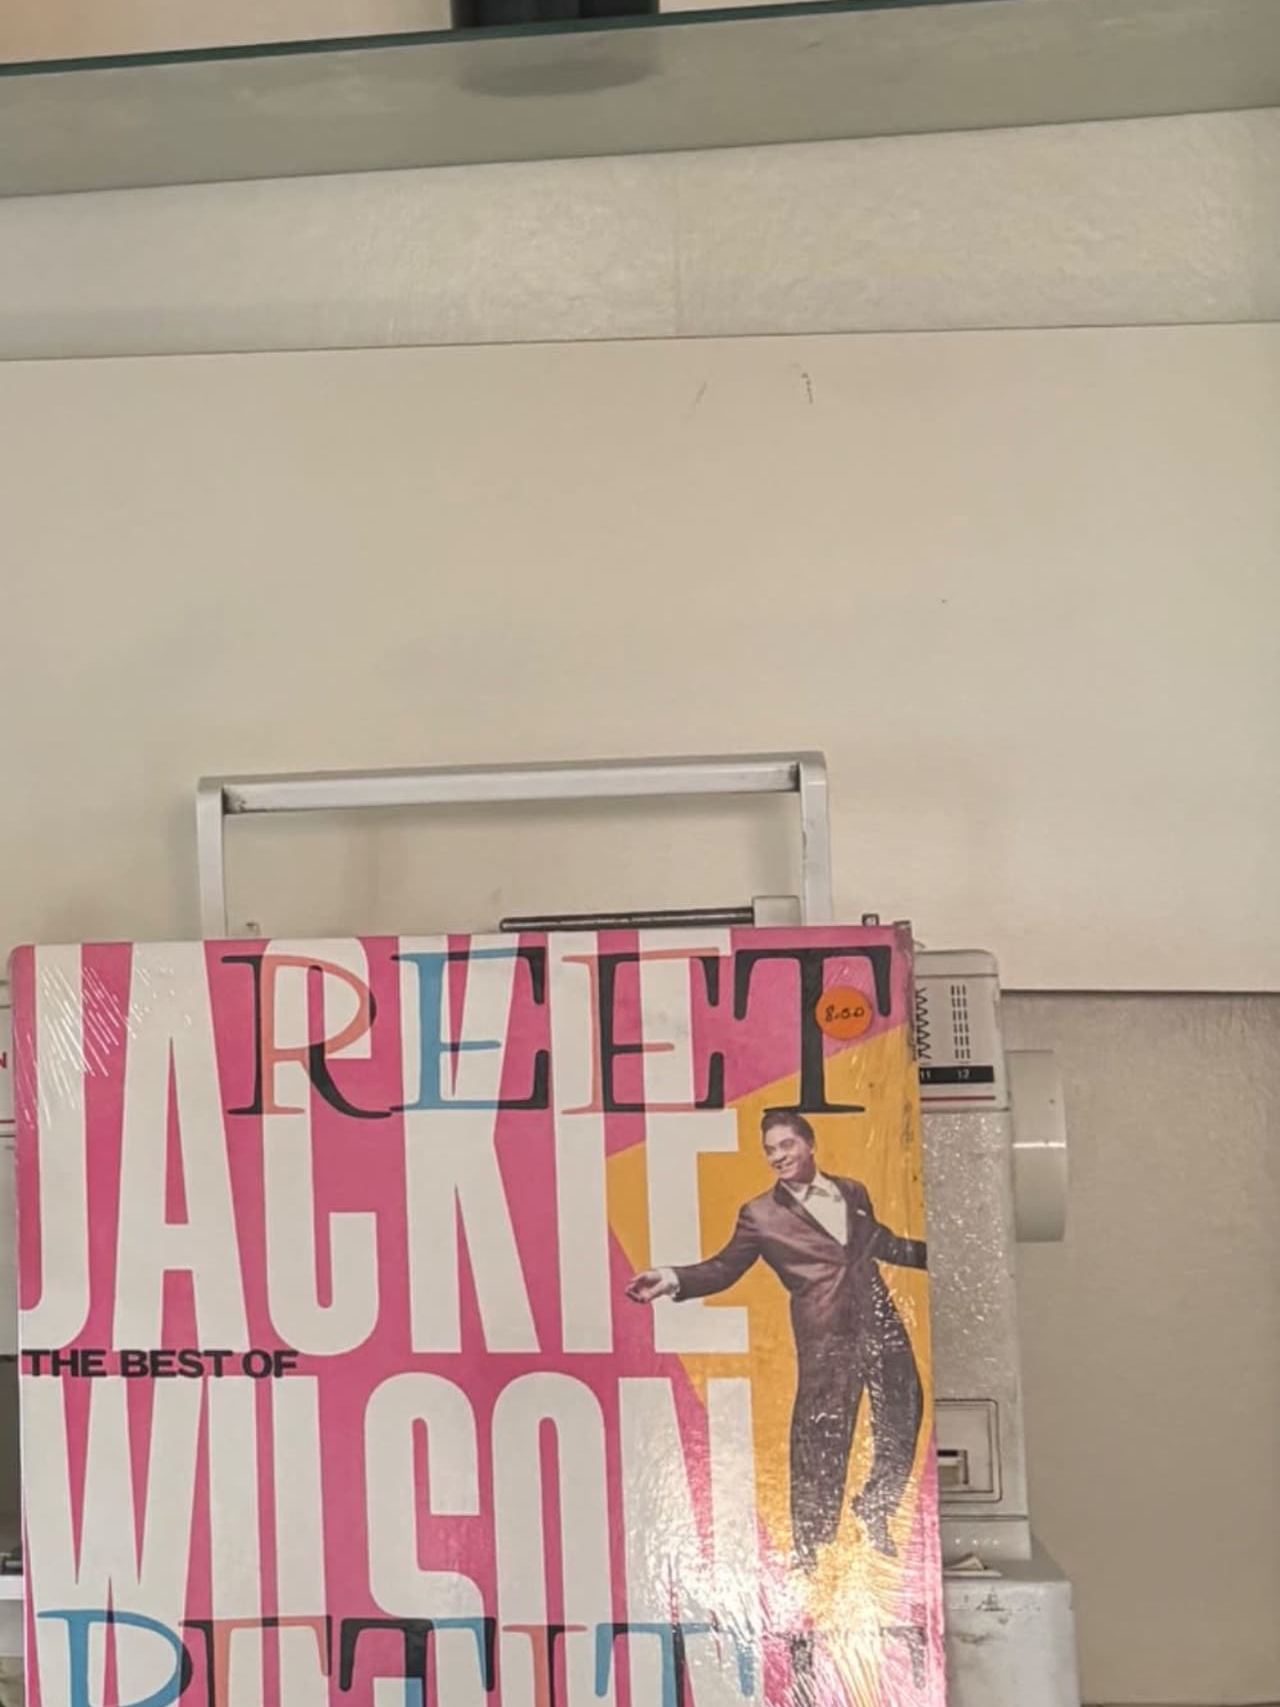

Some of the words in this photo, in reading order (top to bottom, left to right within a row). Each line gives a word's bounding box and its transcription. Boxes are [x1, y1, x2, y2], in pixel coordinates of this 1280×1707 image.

[221, 944, 891, 1118] REET
[16, 927, 749, 1357] JACKIE
[20, 1349, 108, 1377] THE
[120, 1349, 234, 1378] BEST
[241, 1349, 299, 1378] OF
